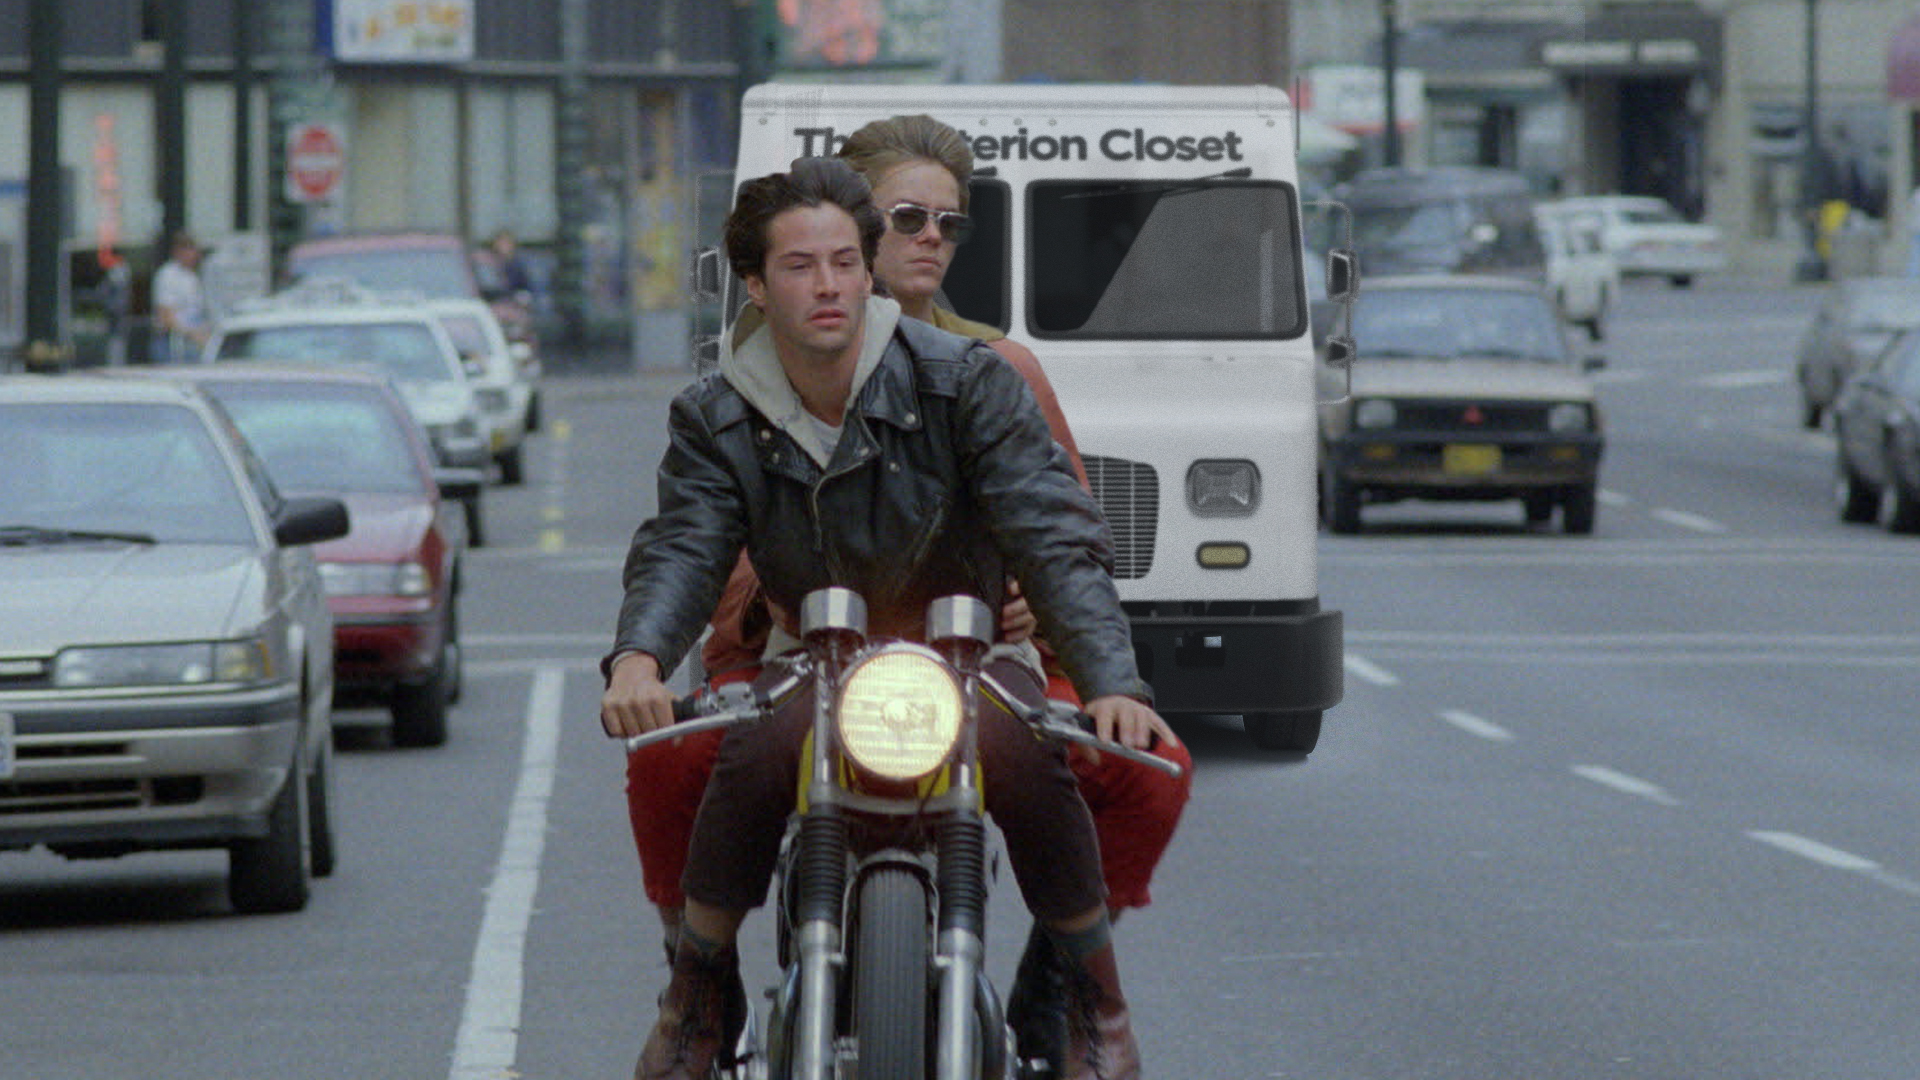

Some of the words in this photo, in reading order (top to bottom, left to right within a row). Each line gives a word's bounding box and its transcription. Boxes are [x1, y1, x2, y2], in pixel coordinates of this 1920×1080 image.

[794, 127, 850, 157] Th
[958, 127, 1087, 161] erion
[1100, 128, 1243, 162] Closet
